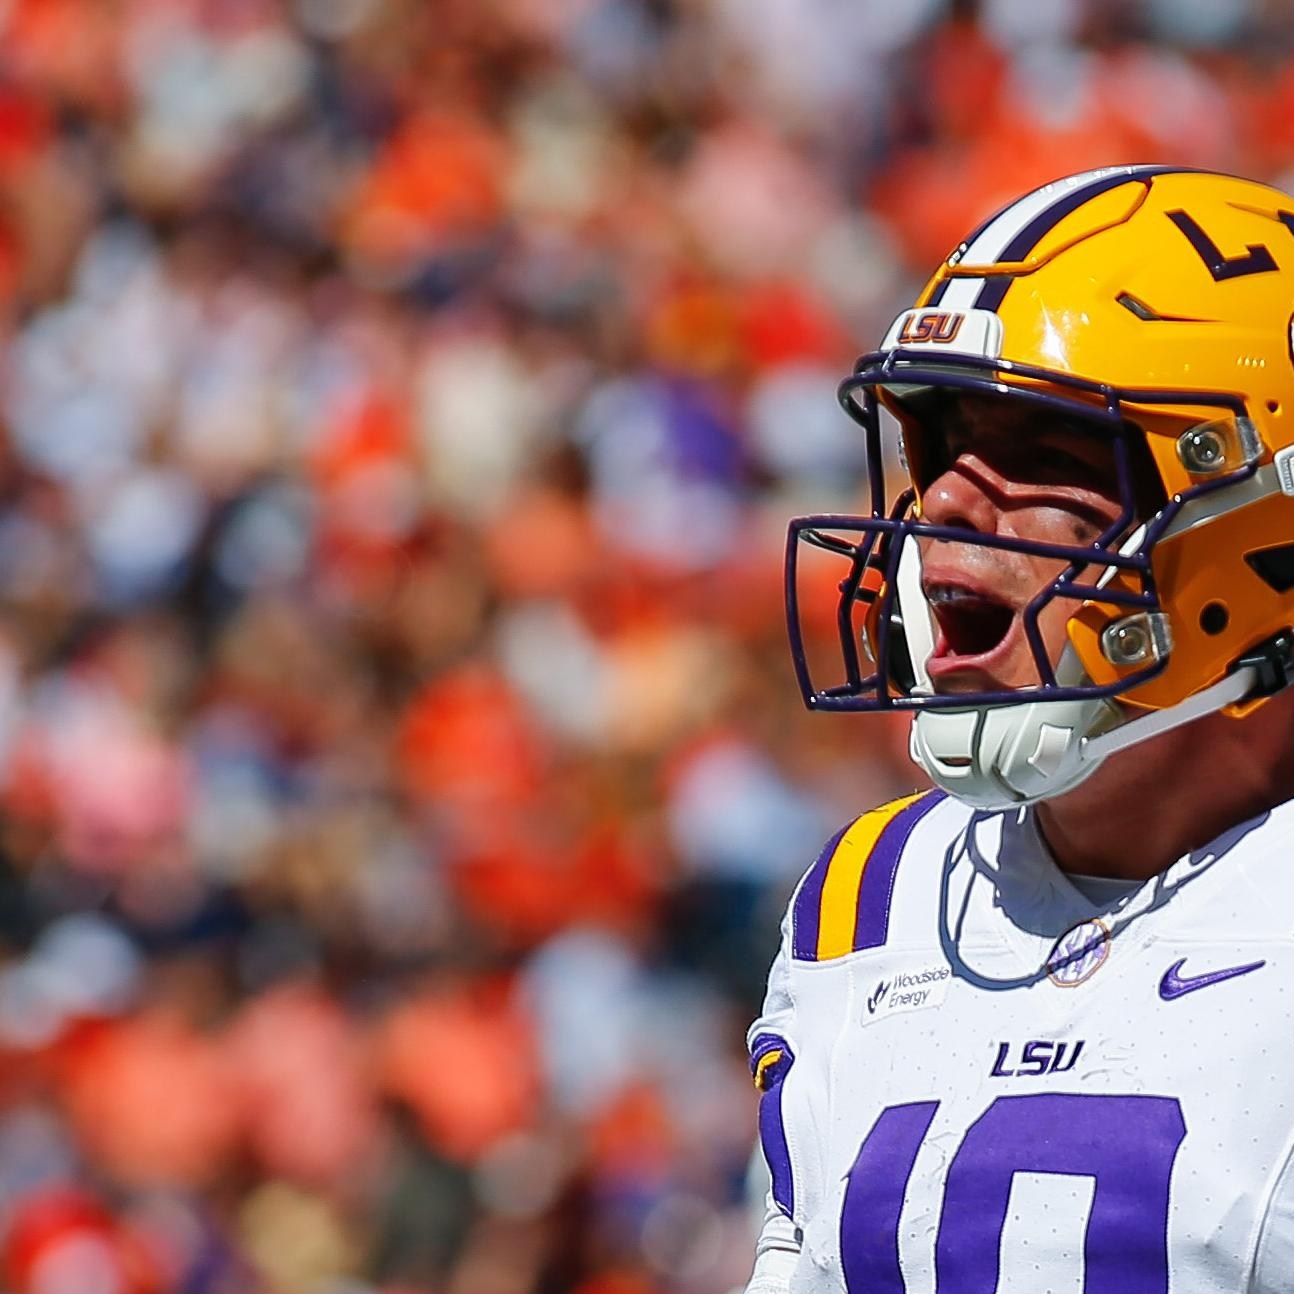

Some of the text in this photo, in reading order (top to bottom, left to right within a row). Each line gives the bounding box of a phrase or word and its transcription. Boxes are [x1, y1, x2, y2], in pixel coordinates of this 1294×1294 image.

[897, 313, 965, 344] LSU
[893, 967, 950, 989] Woodside
[888, 989, 931, 1008] Energy
[989, 1040, 1086, 1078] LSU
